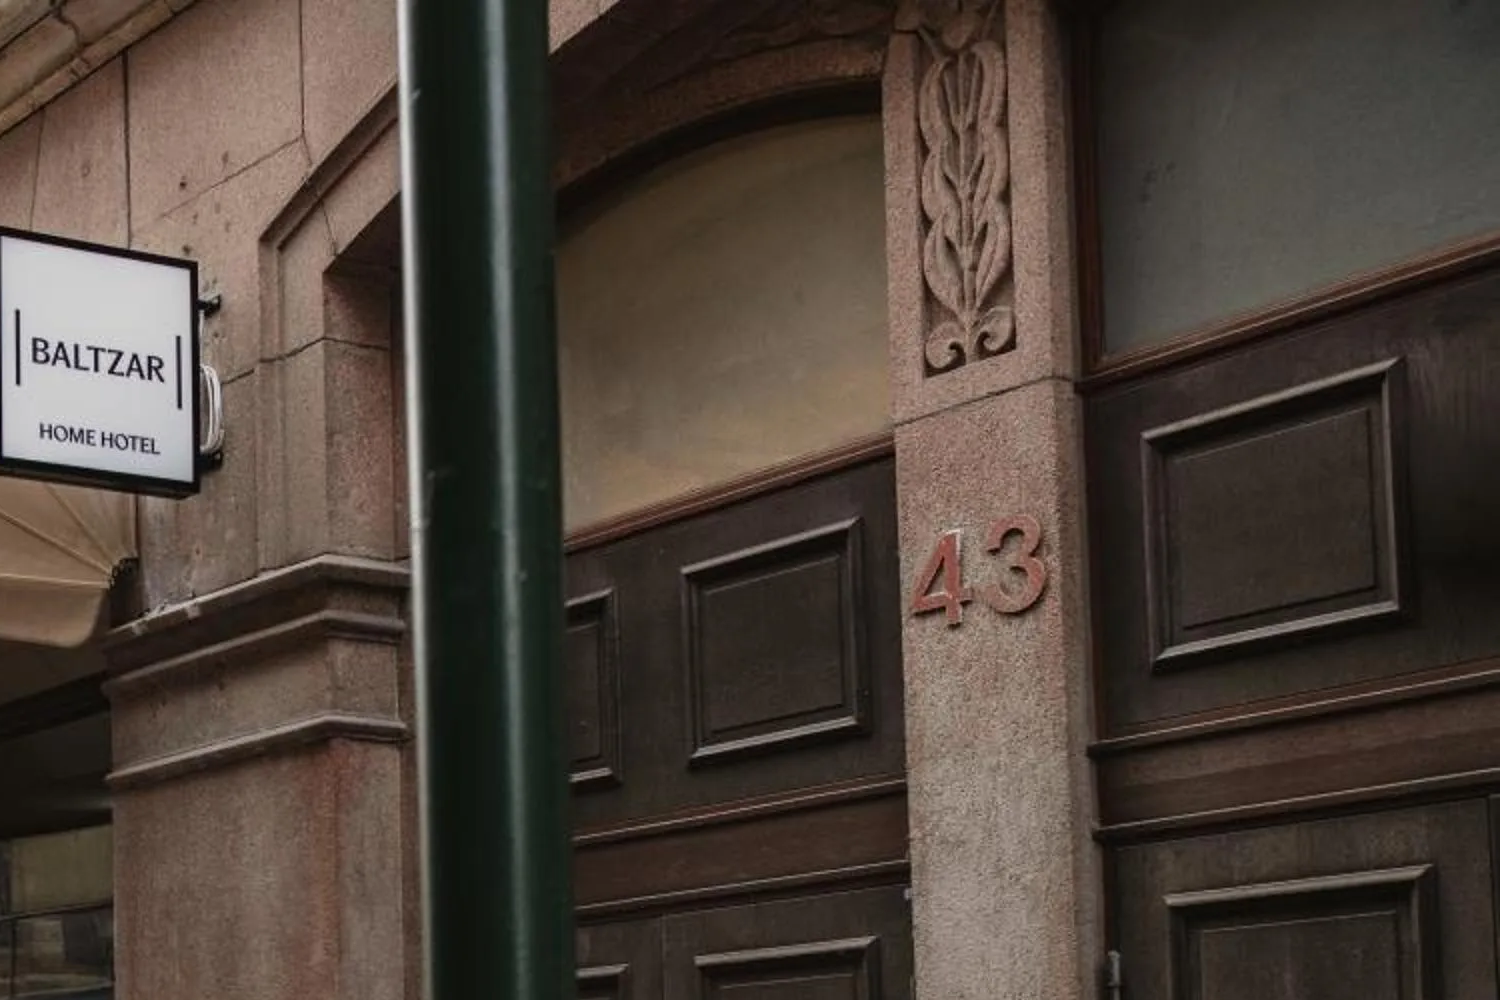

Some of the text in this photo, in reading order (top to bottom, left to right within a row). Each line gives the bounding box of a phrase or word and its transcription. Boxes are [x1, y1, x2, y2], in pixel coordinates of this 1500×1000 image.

[31, 337, 165, 383] BALTZAR
[39, 422, 160, 456] HOME HOTEL
[910, 514, 1046, 626] 43
